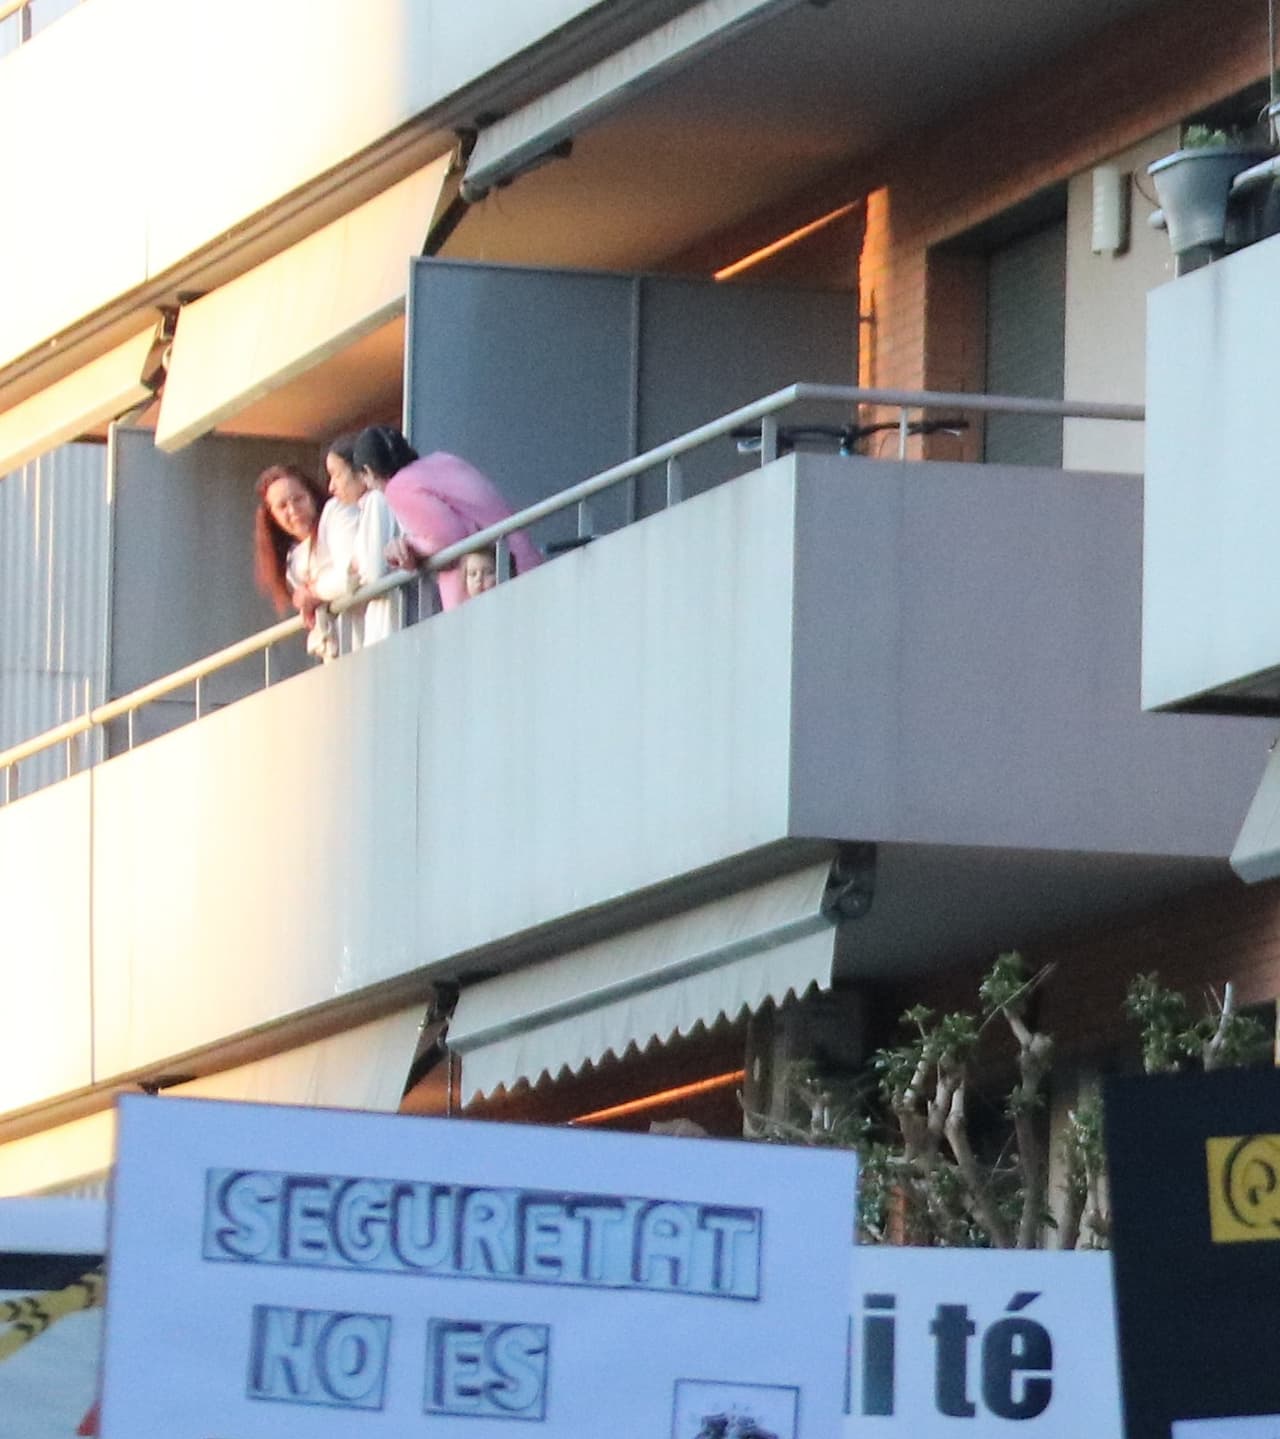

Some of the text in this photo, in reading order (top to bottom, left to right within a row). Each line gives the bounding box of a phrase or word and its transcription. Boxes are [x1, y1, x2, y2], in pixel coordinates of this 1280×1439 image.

[213, 1169, 759, 1294] SEGURETAT
[251, 1307, 548, 1412] NO ES
[844, 1291, 1053, 1420] i té
